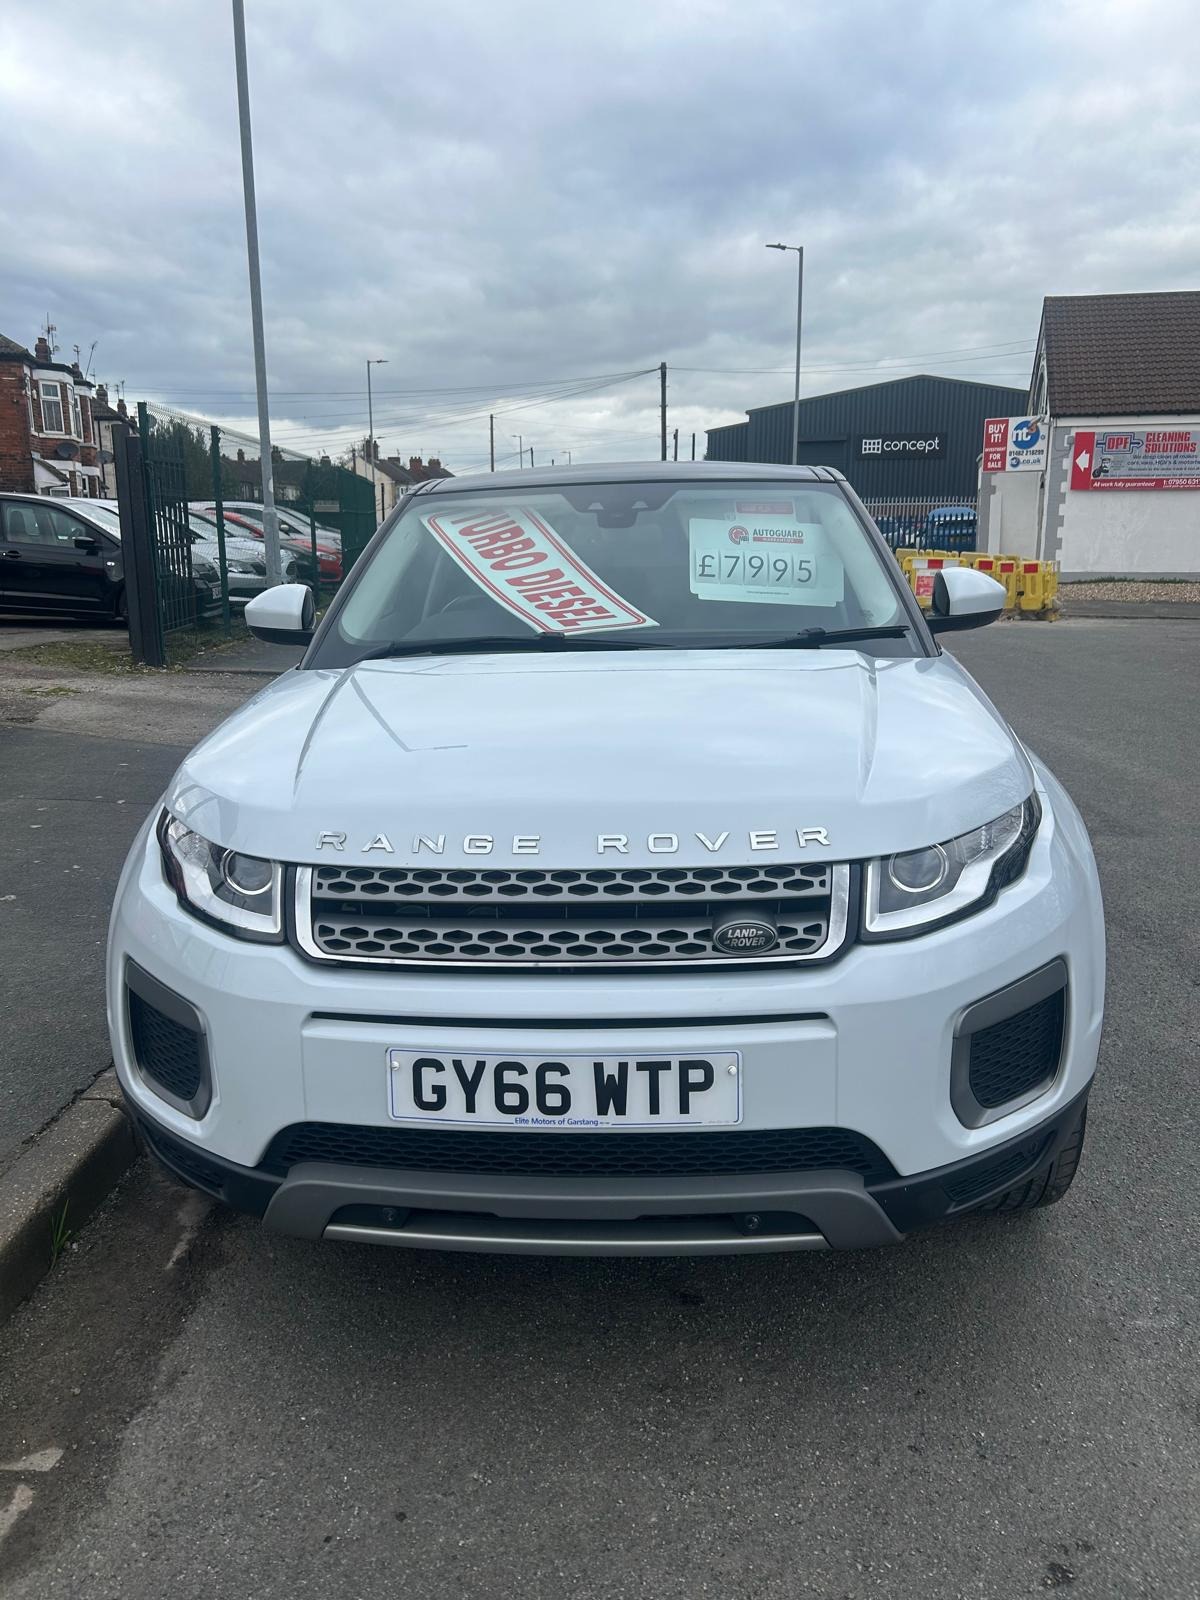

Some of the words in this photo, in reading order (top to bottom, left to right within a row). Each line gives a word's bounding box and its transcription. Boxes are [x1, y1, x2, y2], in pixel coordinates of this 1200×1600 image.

[988, 424, 1006, 433] BUY
[991, 434, 1001, 442] IT!
[1146, 432, 1190, 442] CLEANING
[884, 436, 939, 454] concept
[1107, 437, 1130, 449] DPF
[1145, 442, 1197, 453] SOLUTIONS
[752, 528, 804, 538] AUTOGUARD
[450, 509, 548, 571] TURBO
[698, 554, 812, 583] £7995
[505, 568, 618, 628] DIESEL
[316, 830, 540, 854] RANGE
[596, 826, 832, 854] ROVER
[728, 928, 756, 938] LAND
[731, 937, 766, 946] ROVER
[412, 1057, 571, 1115] GY66
[594, 1059, 715, 1116] WTP
[514, 1117, 530, 1125] Elite
[531, 1118, 556, 1126] Motors
[558, 1117, 566, 1125] of
[567, 1118, 598, 1127] Garstang
